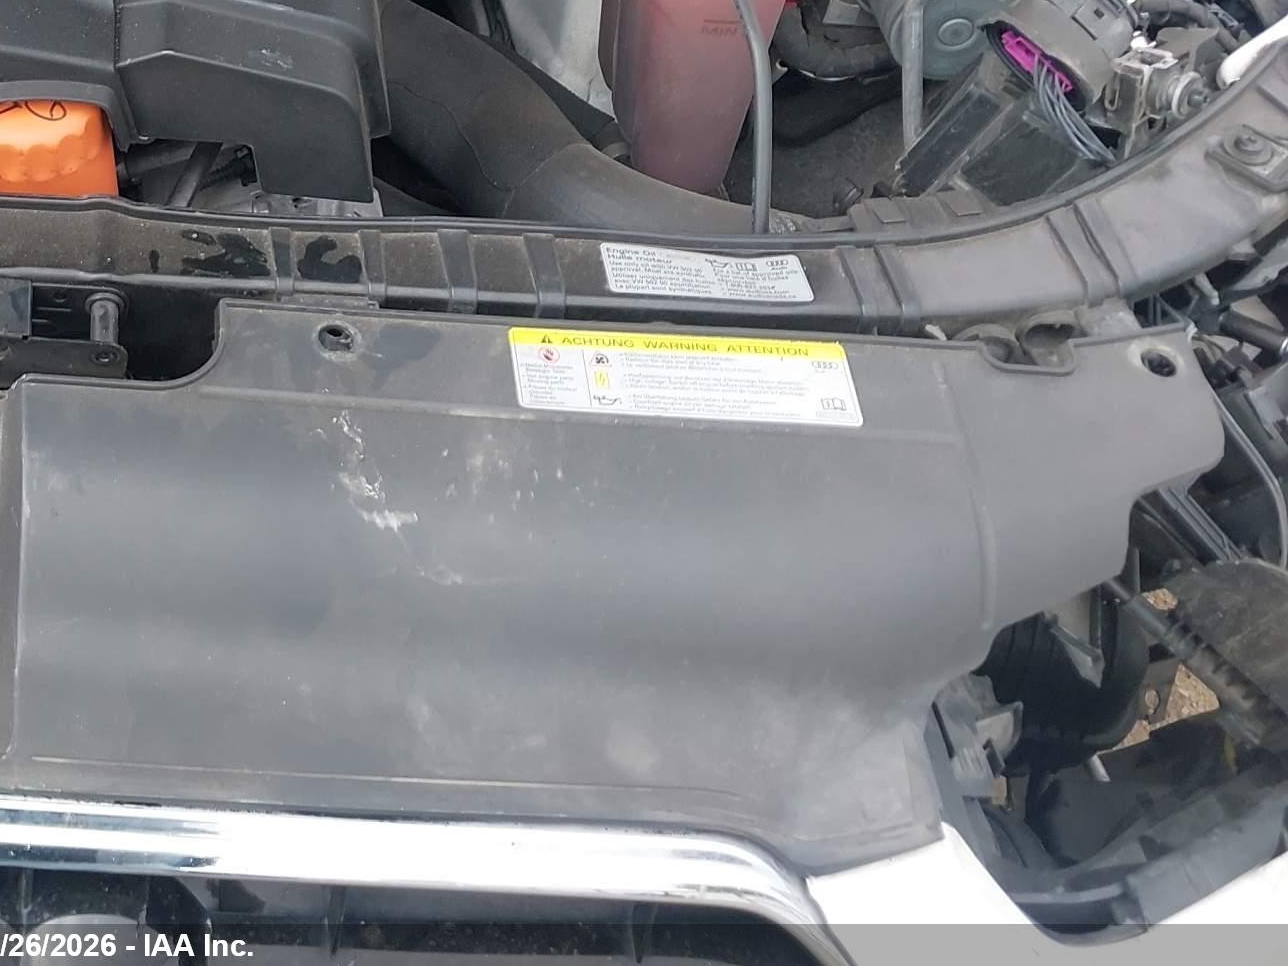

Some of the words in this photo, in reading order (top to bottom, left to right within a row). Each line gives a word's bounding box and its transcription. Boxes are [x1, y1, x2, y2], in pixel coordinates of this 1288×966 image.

[701, 25, 738, 36] MIN
[605, 247, 640, 256] Engine
[635, 256, 673, 264] moteur
[562, 336, 634, 348] ACHTUNG
[643, 340, 718, 352] WARNING
[727, 344, 810, 356] ATTENTION
